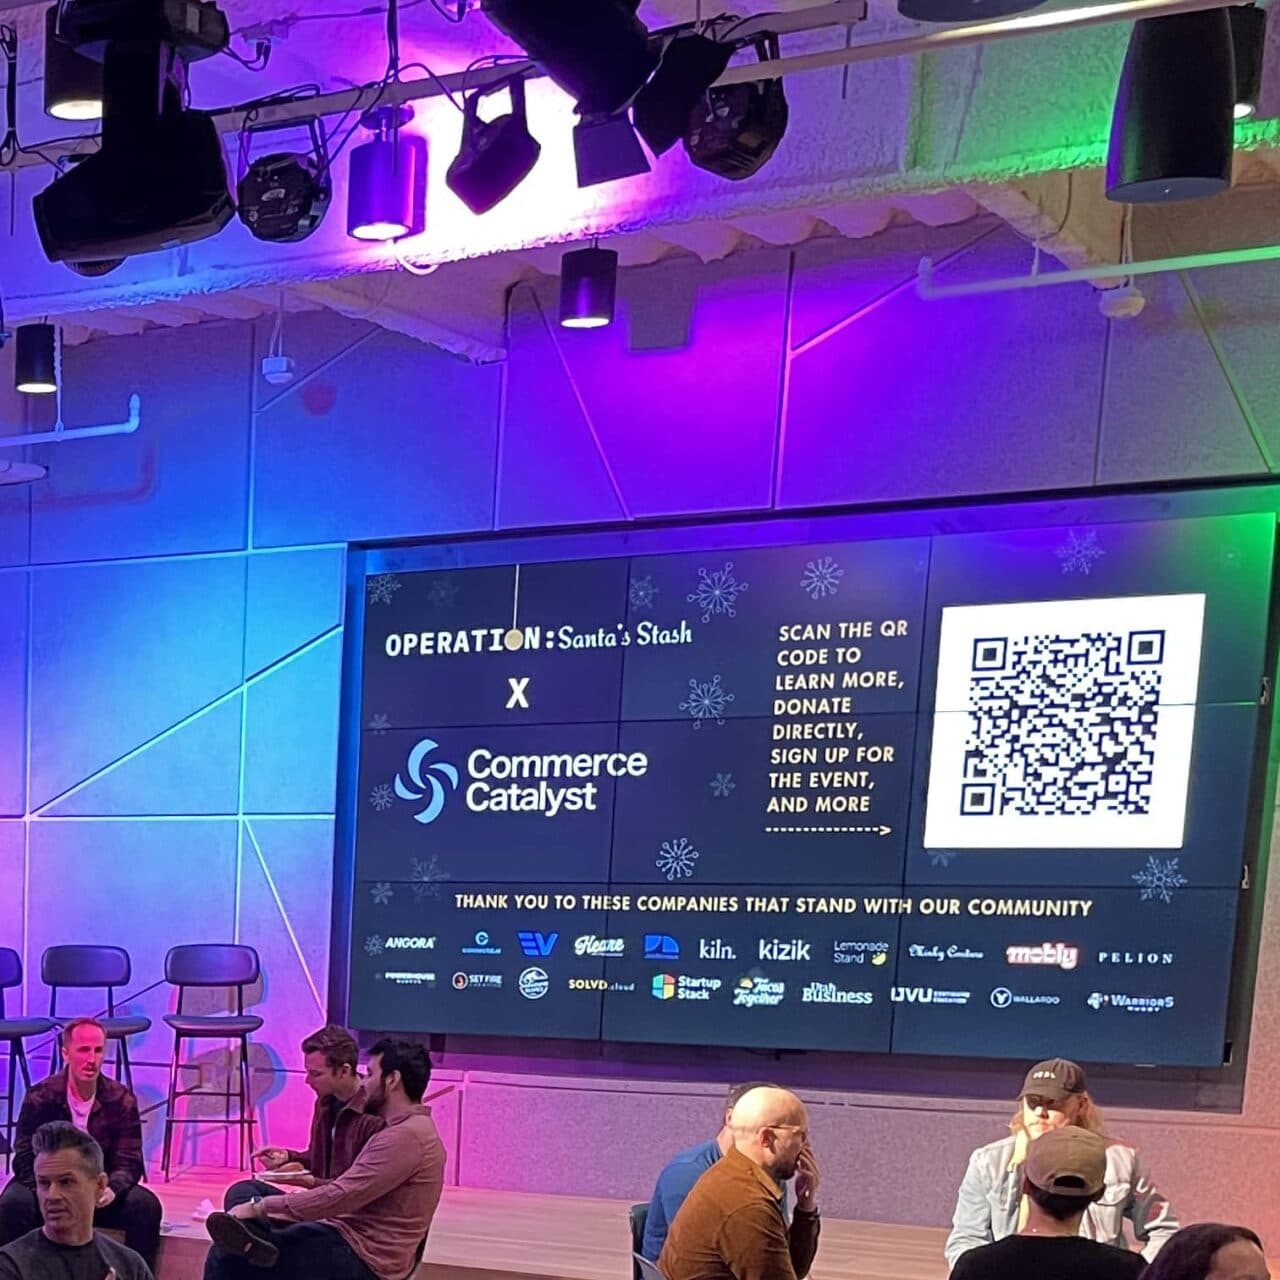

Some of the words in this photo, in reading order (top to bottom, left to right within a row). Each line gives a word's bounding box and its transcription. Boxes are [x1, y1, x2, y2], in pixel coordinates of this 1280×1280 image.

[636, 620, 693, 646] Stash
[779, 624, 831, 642] SCAN
[838, 621, 873, 639] THE
[880, 620, 908, 637] QR
[777, 649, 828, 666] CODE
[835, 647, 861, 664] TO
[775, 673, 835, 691] LEARN
[842, 671, 904, 689] MORE,
[505, 677, 530, 708] X
[774, 697, 851, 715] DONATE
[772, 722, 864, 740] DIRECTLY,
[467, 748, 648, 780] Commerce
[771, 748, 817, 764] SIGN
[824, 747, 849, 764] UP
[856, 746, 894, 763] FOR
[769, 772, 801, 788] THE
[809, 771, 875, 790] EVENT,
[466, 781, 598, 817] Catalyst
[766, 796, 808, 813] AND
[815, 796, 870, 812] MORE
[455, 894, 508, 909] THANK
[514, 894, 548, 909] YOU
[555, 895, 576, 909] TO
[582, 896, 630, 911] THESE
[637, 896, 738, 912] COMPANIES
[745, 897, 789, 912] THAT
[796, 898, 857, 913] STAND
[864, 899, 912, 914] WITH
[919, 899, 960, 915] OUR
[968, 899, 1093, 917] COMMUNITY
[385, 936, 435, 949] ANGORA
[699, 938, 737, 960] kiln.
[759, 939, 811, 960] kizik
[834, 940, 889, 952] Lemonade
[834, 953, 864, 964] Stand
[1098, 952, 1173, 964] PELION
[677, 975, 722, 990] Startup
[677, 988, 710, 1000] Stack
[733, 988, 784, 1008] Together
[802, 987, 873, 1004] Business
